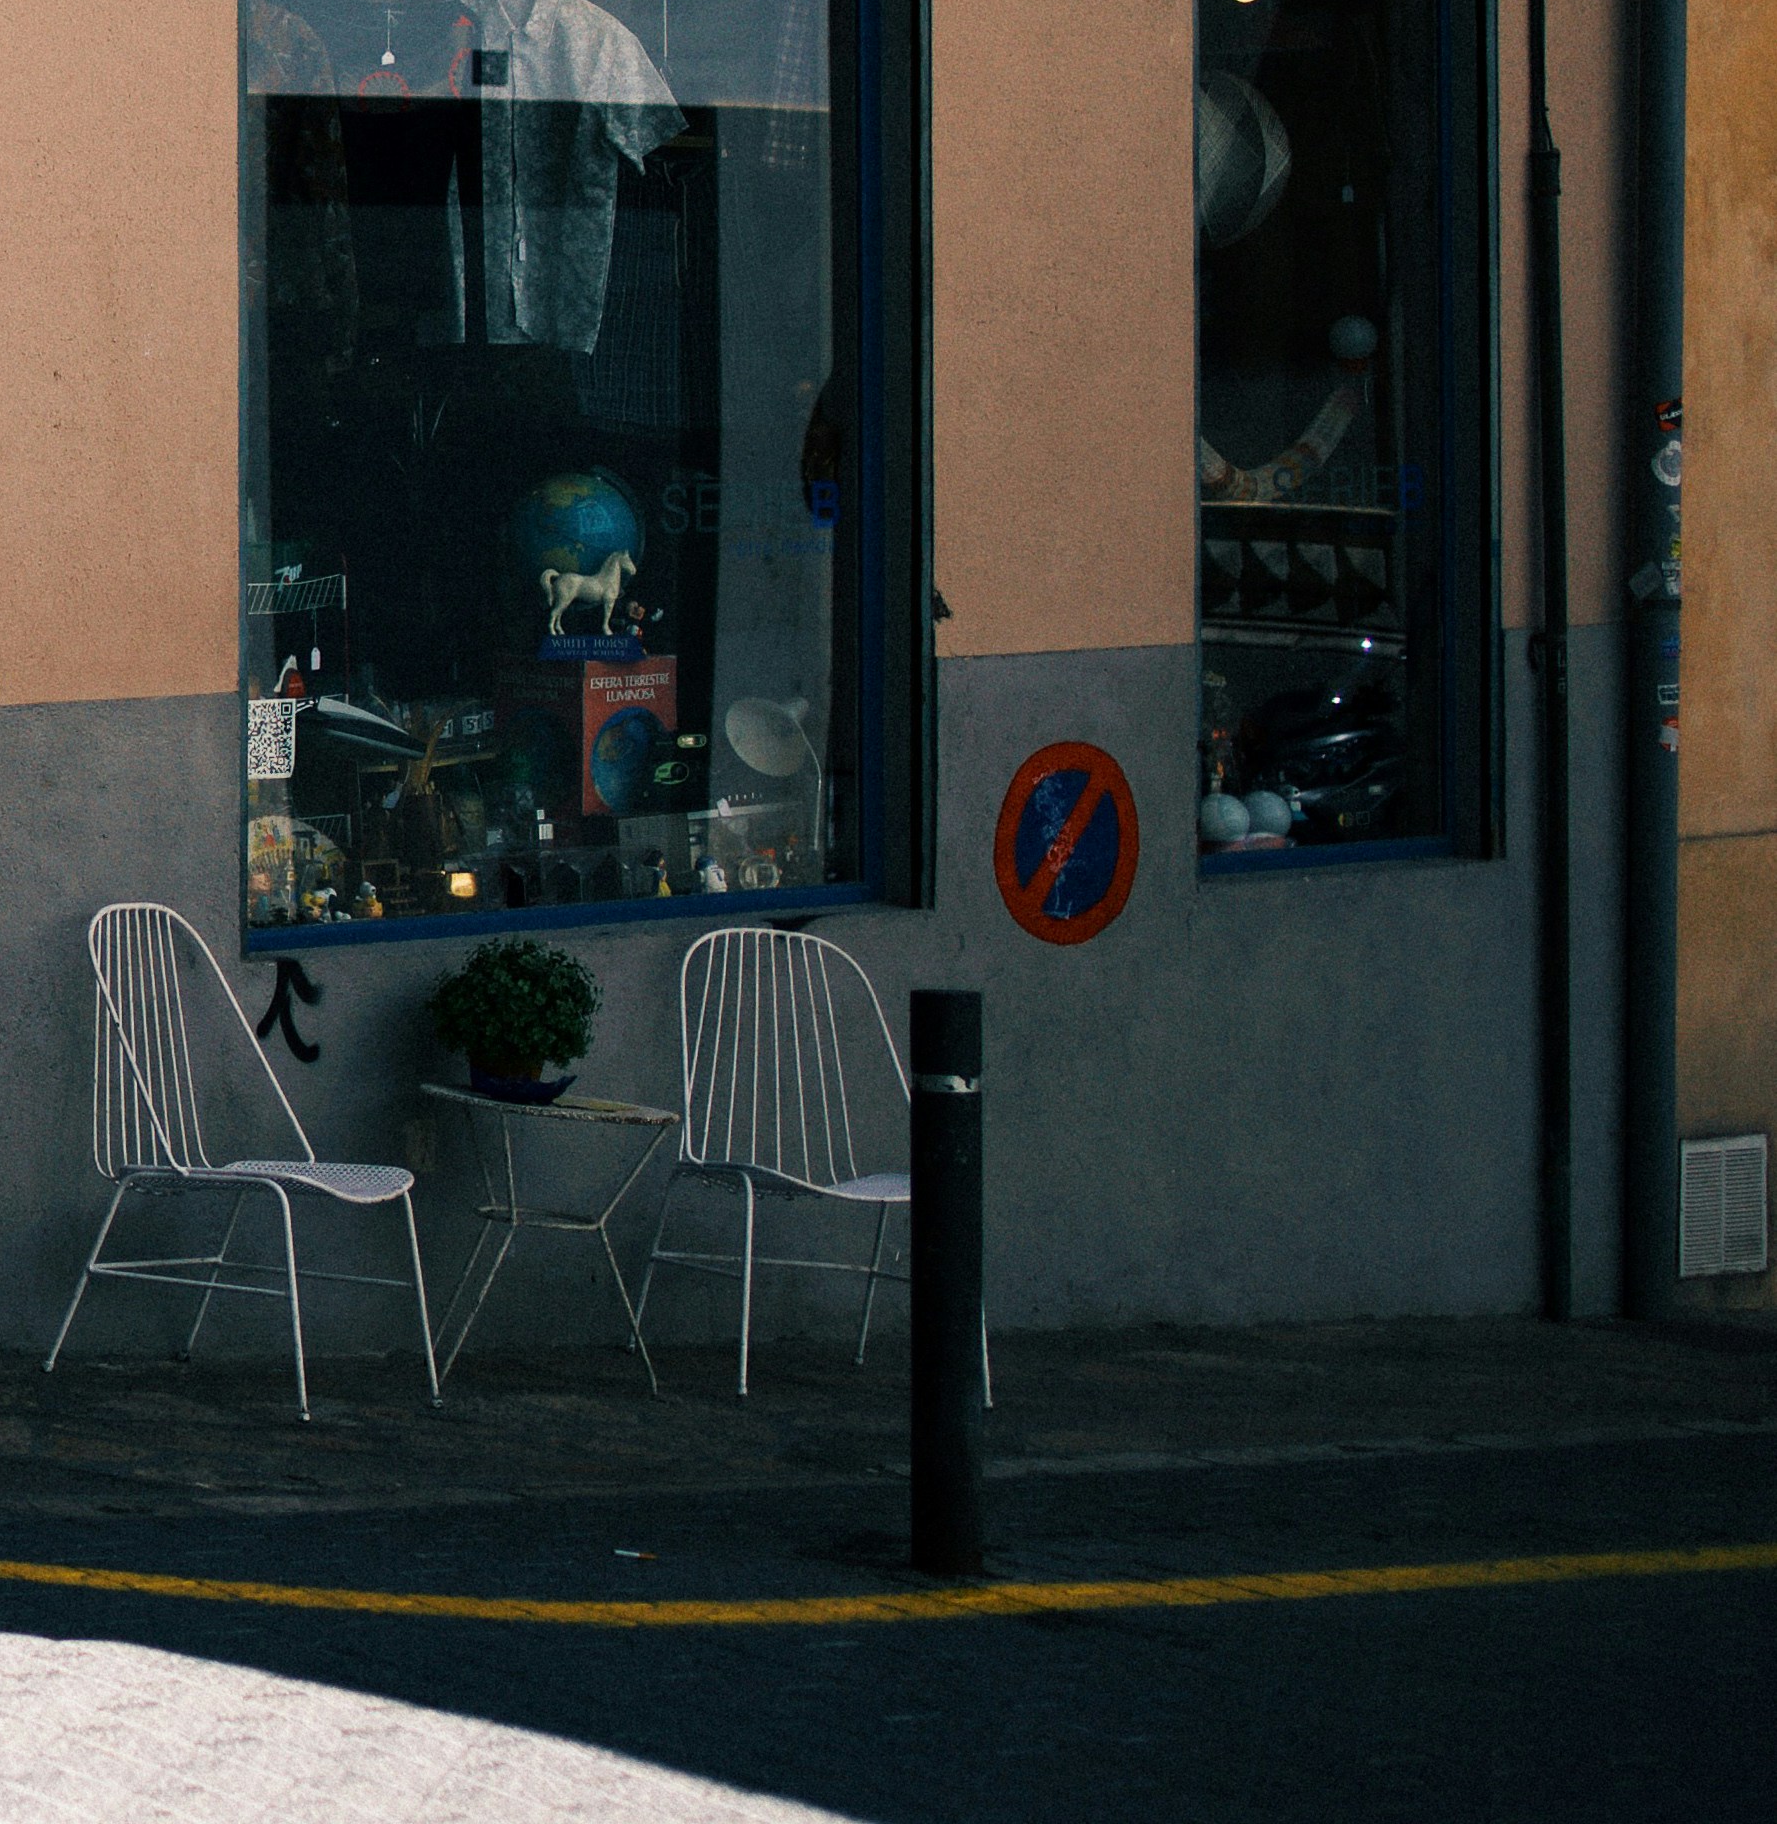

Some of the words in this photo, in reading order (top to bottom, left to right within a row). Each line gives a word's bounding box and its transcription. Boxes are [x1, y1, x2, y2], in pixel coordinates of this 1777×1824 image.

[551, 638, 587, 648] WHITE
[593, 638, 629, 649] HORSE
[590, 676, 623, 690] ESFERA
[625, 672, 670, 688] TERRESTRE
[606, 687, 656, 703] LUMINOSA
